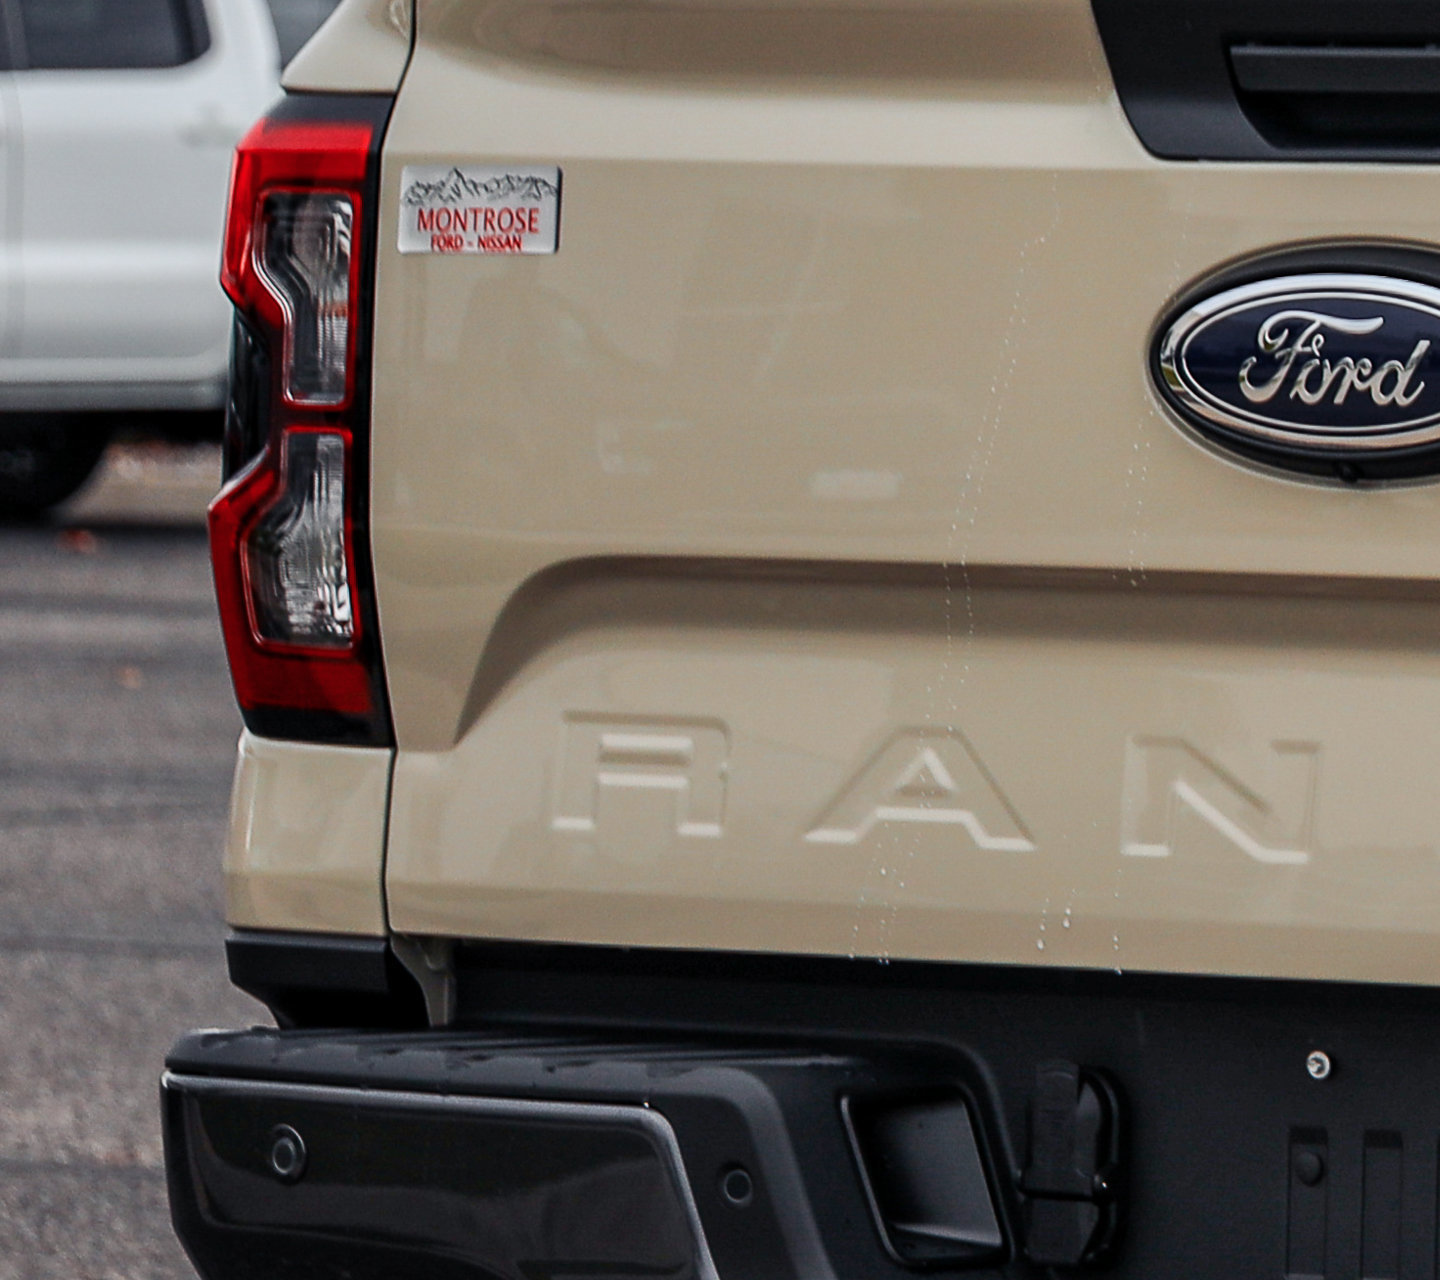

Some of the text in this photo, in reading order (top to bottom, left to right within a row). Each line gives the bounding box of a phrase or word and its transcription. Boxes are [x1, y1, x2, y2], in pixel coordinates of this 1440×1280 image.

[416, 207, 541, 234] MONTROSE
[430, 235, 464, 252] FORD
[477, 235, 522, 252] NISSAN
[1238, 309, 1431, 408] Ford
